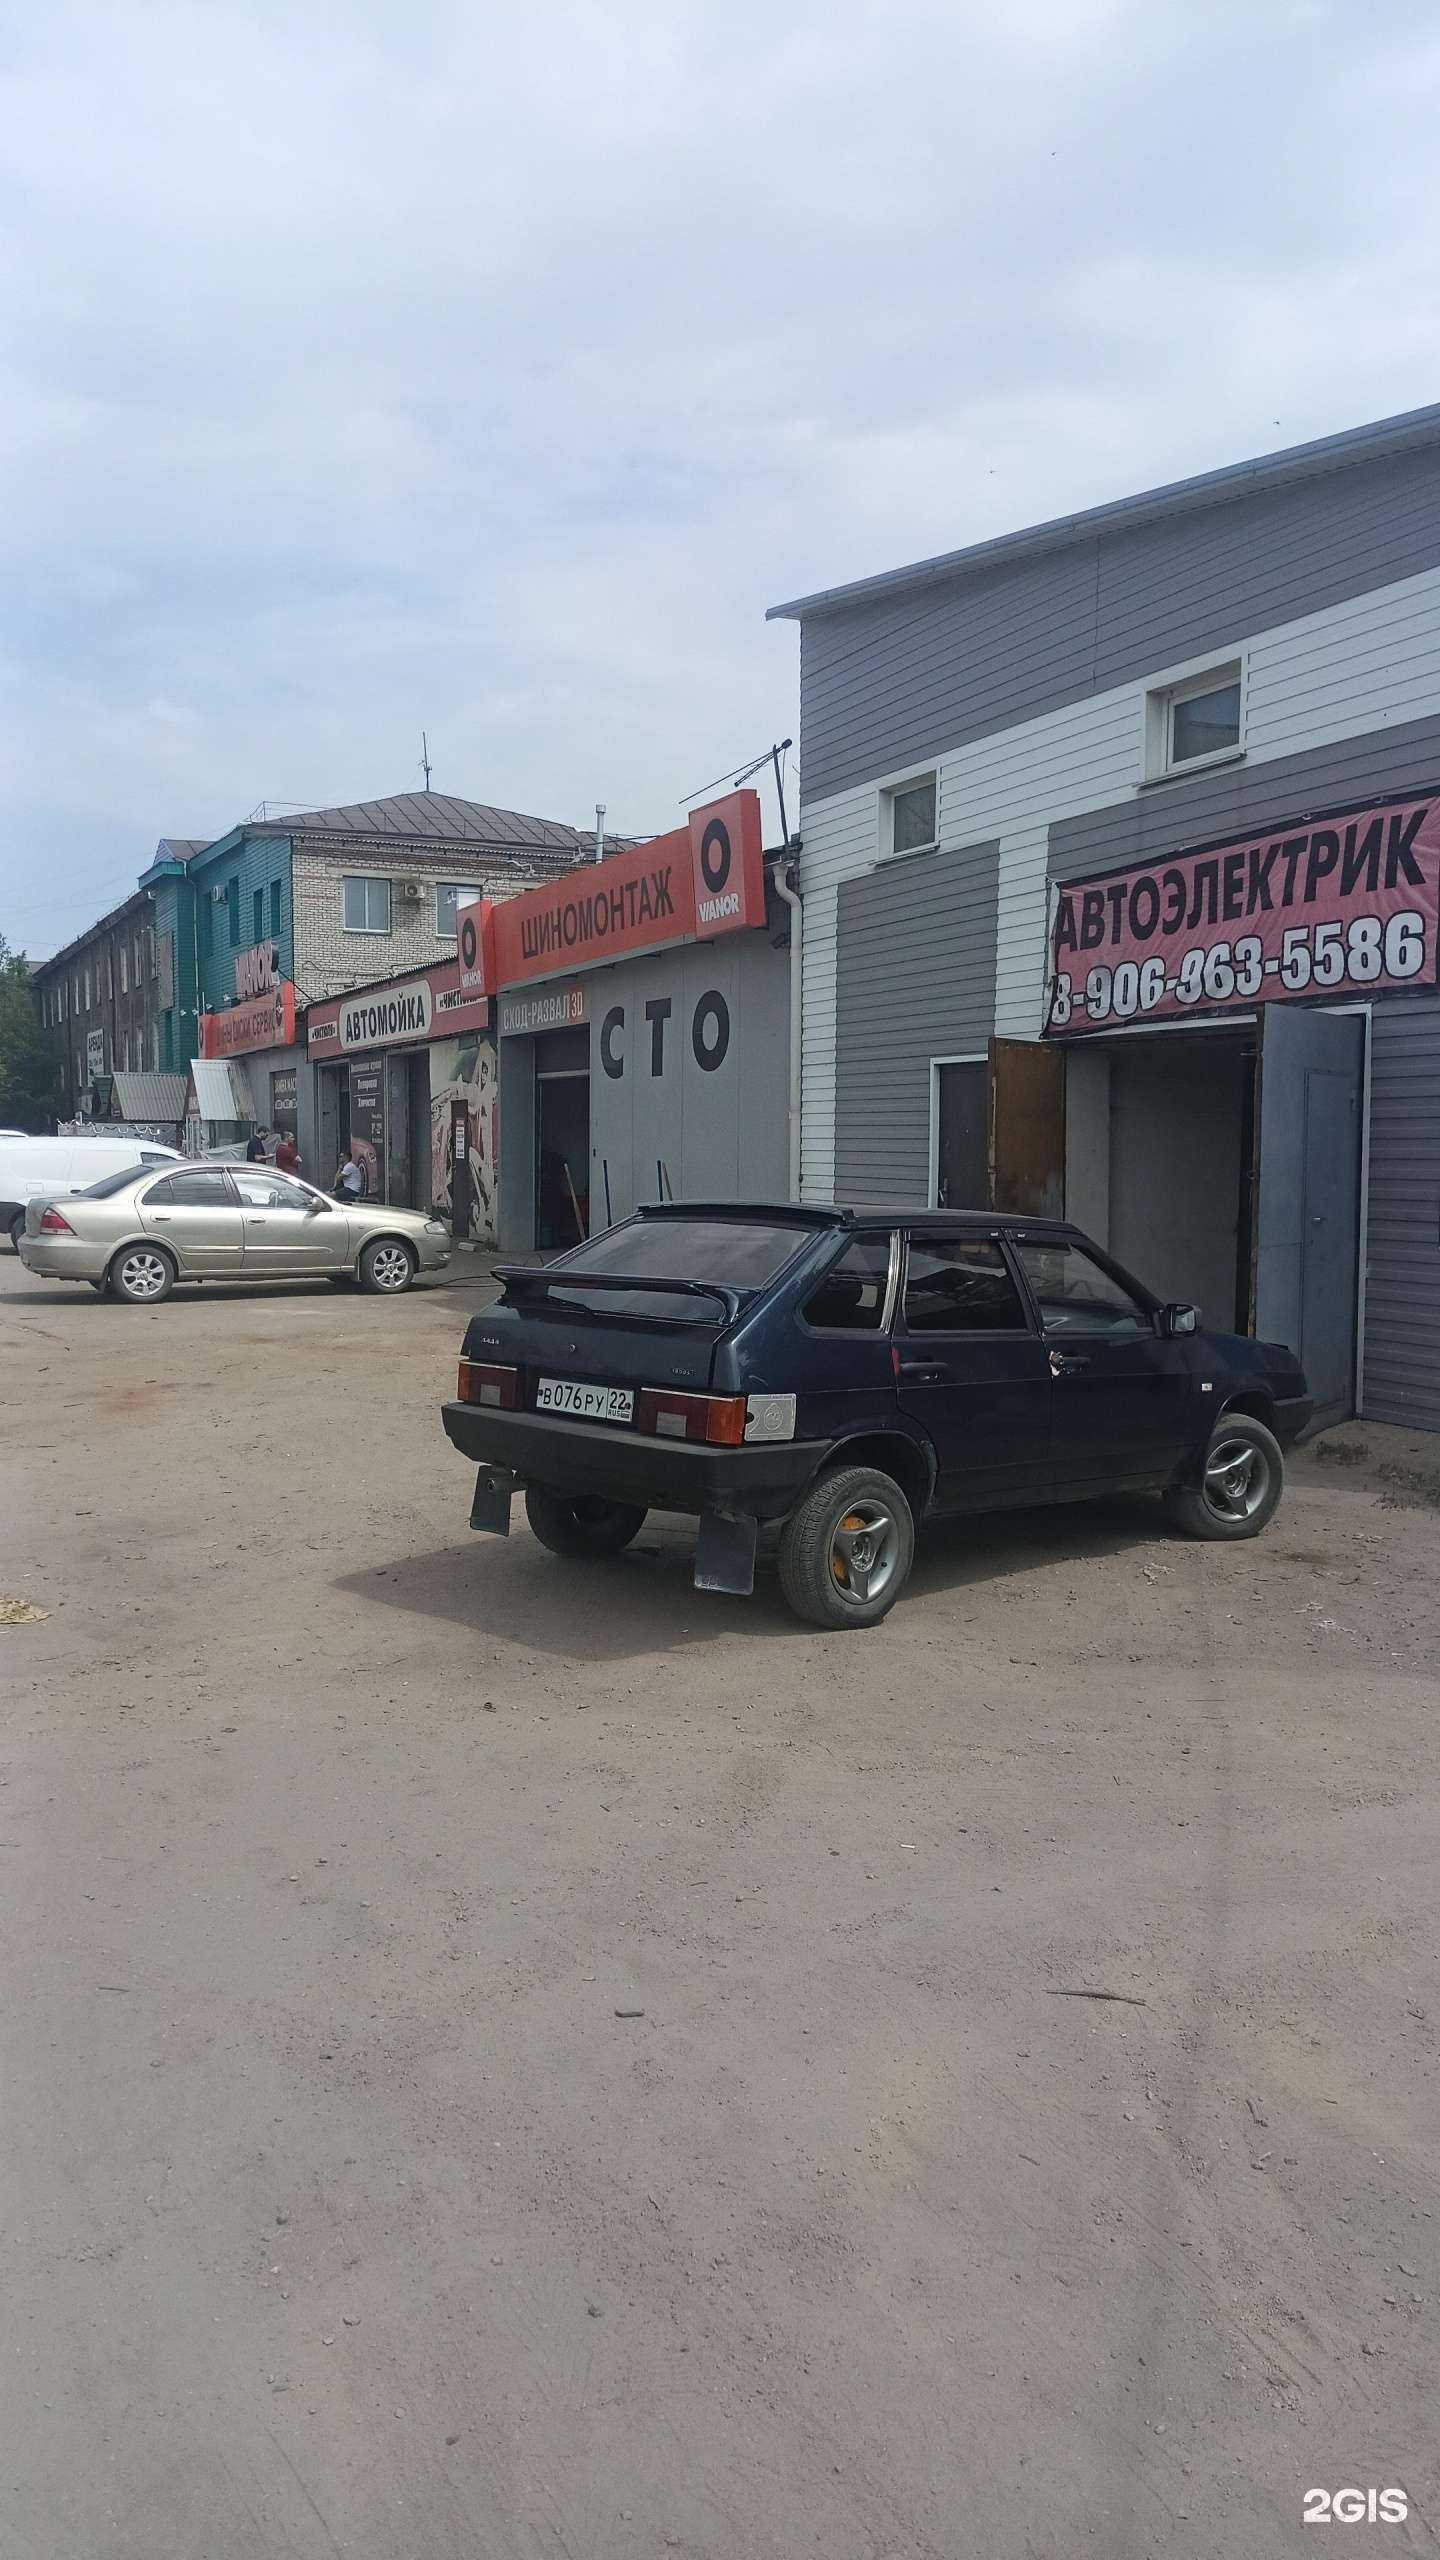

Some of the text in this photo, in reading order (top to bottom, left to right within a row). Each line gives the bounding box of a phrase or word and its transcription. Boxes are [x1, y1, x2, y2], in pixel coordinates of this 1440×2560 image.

[1053, 808, 1428, 953] АВТОЭЛЕКТРИК
[521, 866, 674, 959] ШИНОМОНТАЖ
[698, 892, 740, 923] VIANOR
[1050, 909, 1426, 1026] 8-906-963-5586
[346, 992, 426, 1042] АВТОМОЙКА
[503, 991, 583, 1031] СХОД-РАЗВАЛ 3D
[542, 1385, 626, 1413] В076РУ 22
